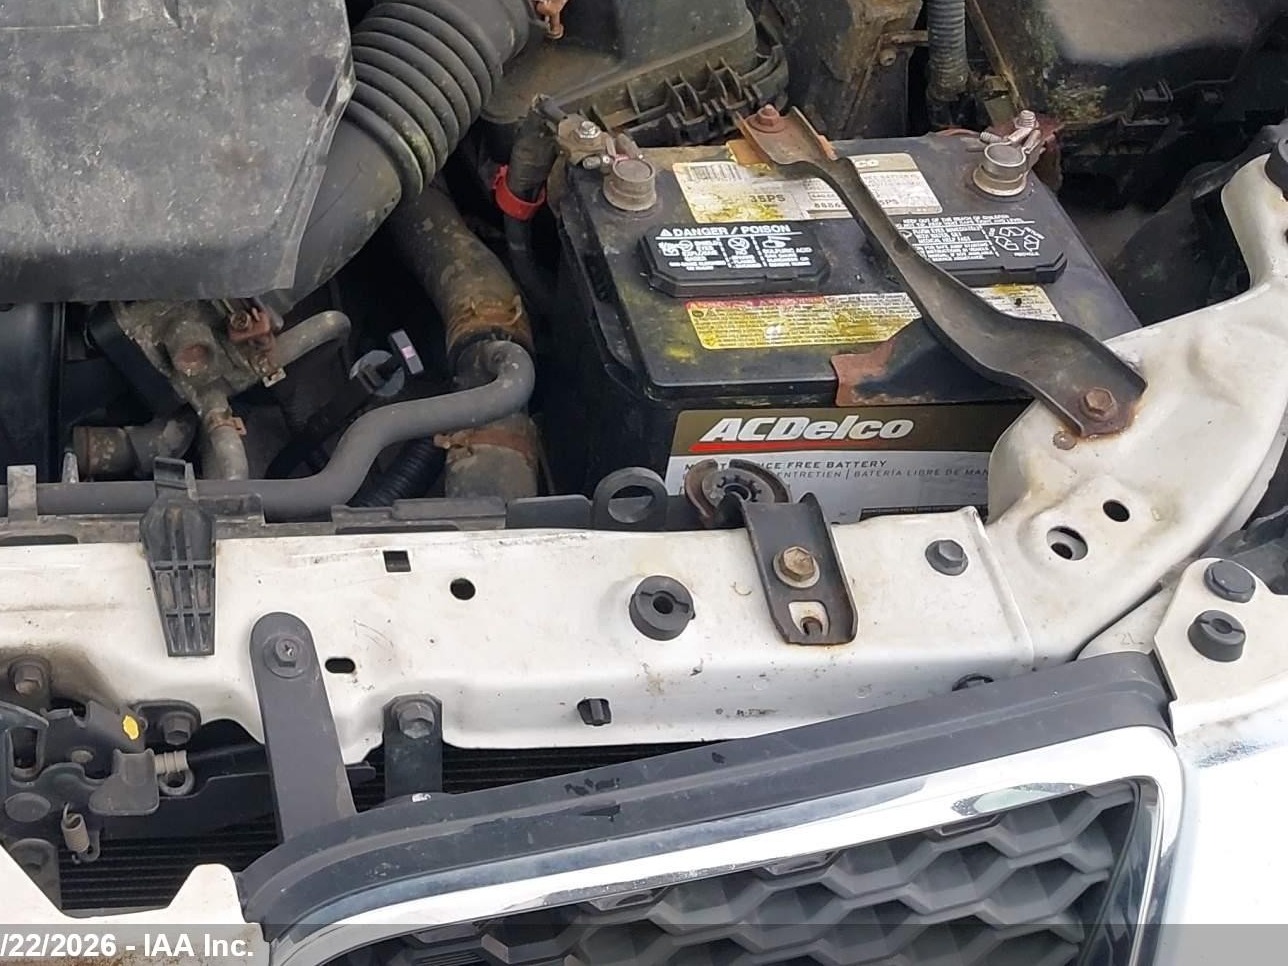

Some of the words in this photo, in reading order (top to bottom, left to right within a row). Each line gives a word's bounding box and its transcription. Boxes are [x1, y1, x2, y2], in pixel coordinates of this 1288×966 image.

[672, 225, 728, 236] DANGER
[740, 224, 791, 234] POISON
[699, 415, 914, 442] ACDelco
[786, 461, 825, 469] FREE
[826, 459, 887, 469] BATTERY
